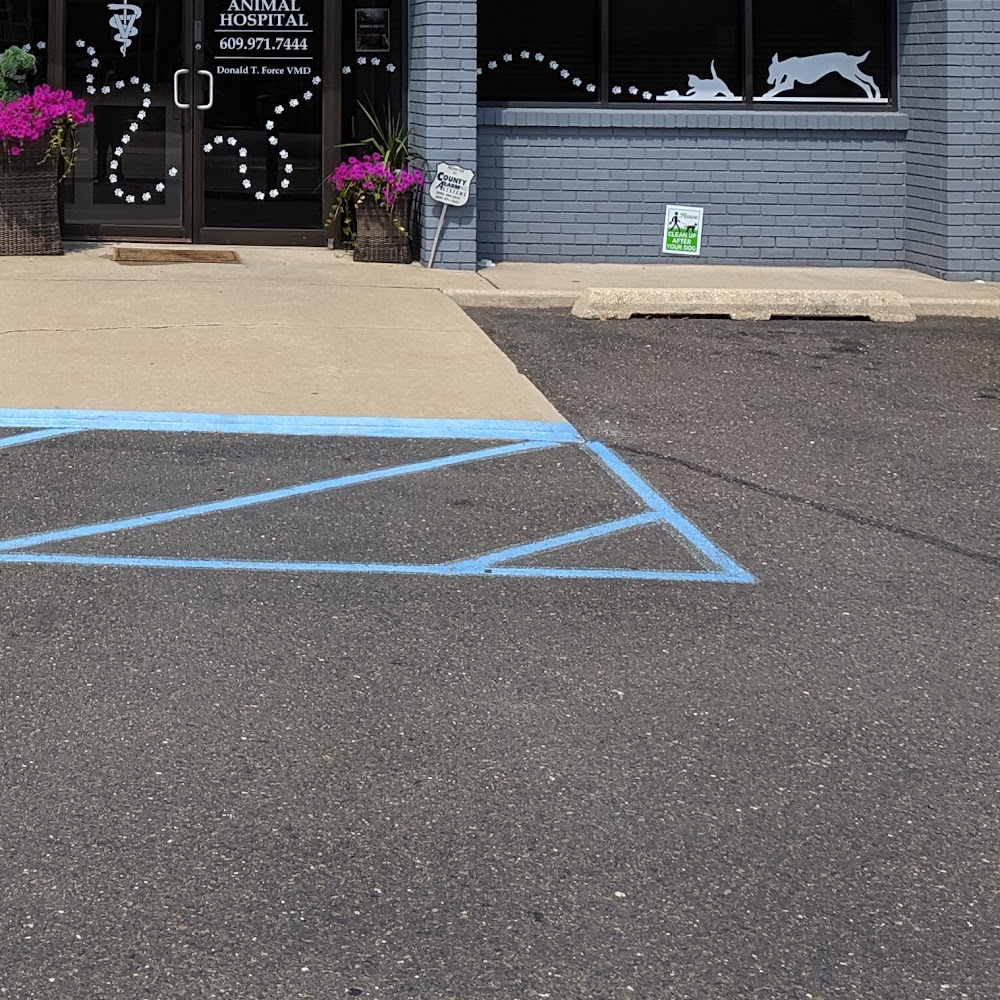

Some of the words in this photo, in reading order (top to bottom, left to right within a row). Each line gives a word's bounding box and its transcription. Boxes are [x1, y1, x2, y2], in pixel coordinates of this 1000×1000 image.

[219, 13, 309, 27] HOSPITAL
[219, 37, 309, 50] 609.971.7444
[216, 66, 249, 75] Donald
[250, 66, 260, 75] T.
[261, 66, 284, 75] Force
[286, 67, 311, 75] VMD
[437, 172, 467, 186] COUNTY
